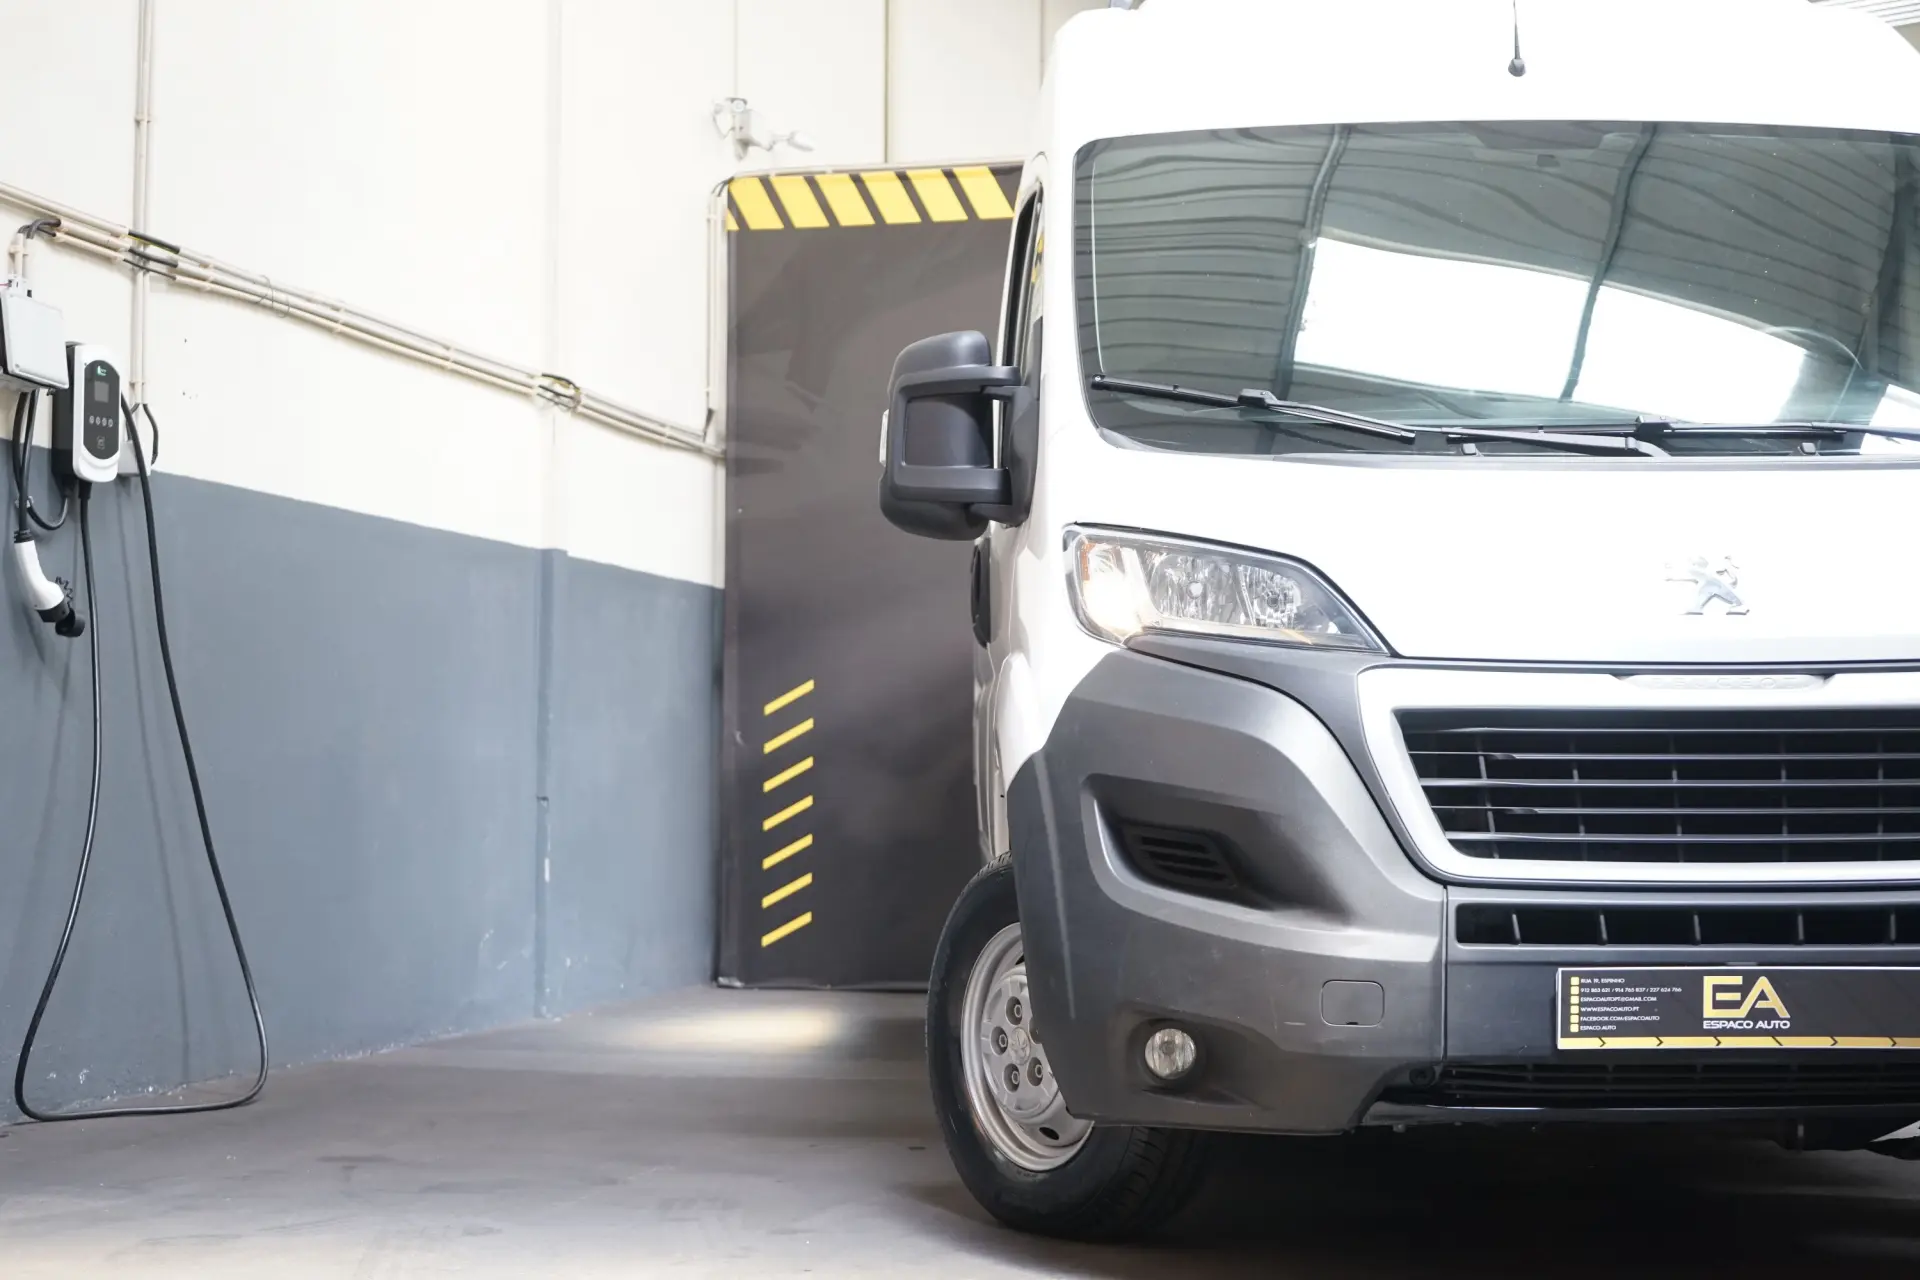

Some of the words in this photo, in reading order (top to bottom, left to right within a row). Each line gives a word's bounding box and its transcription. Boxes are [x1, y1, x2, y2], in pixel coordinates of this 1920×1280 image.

[1703, 975, 1791, 1018] EA
[1703, 1020, 1754, 1029] ESPACO
[1755, 1020, 1791, 1029] AUTO
